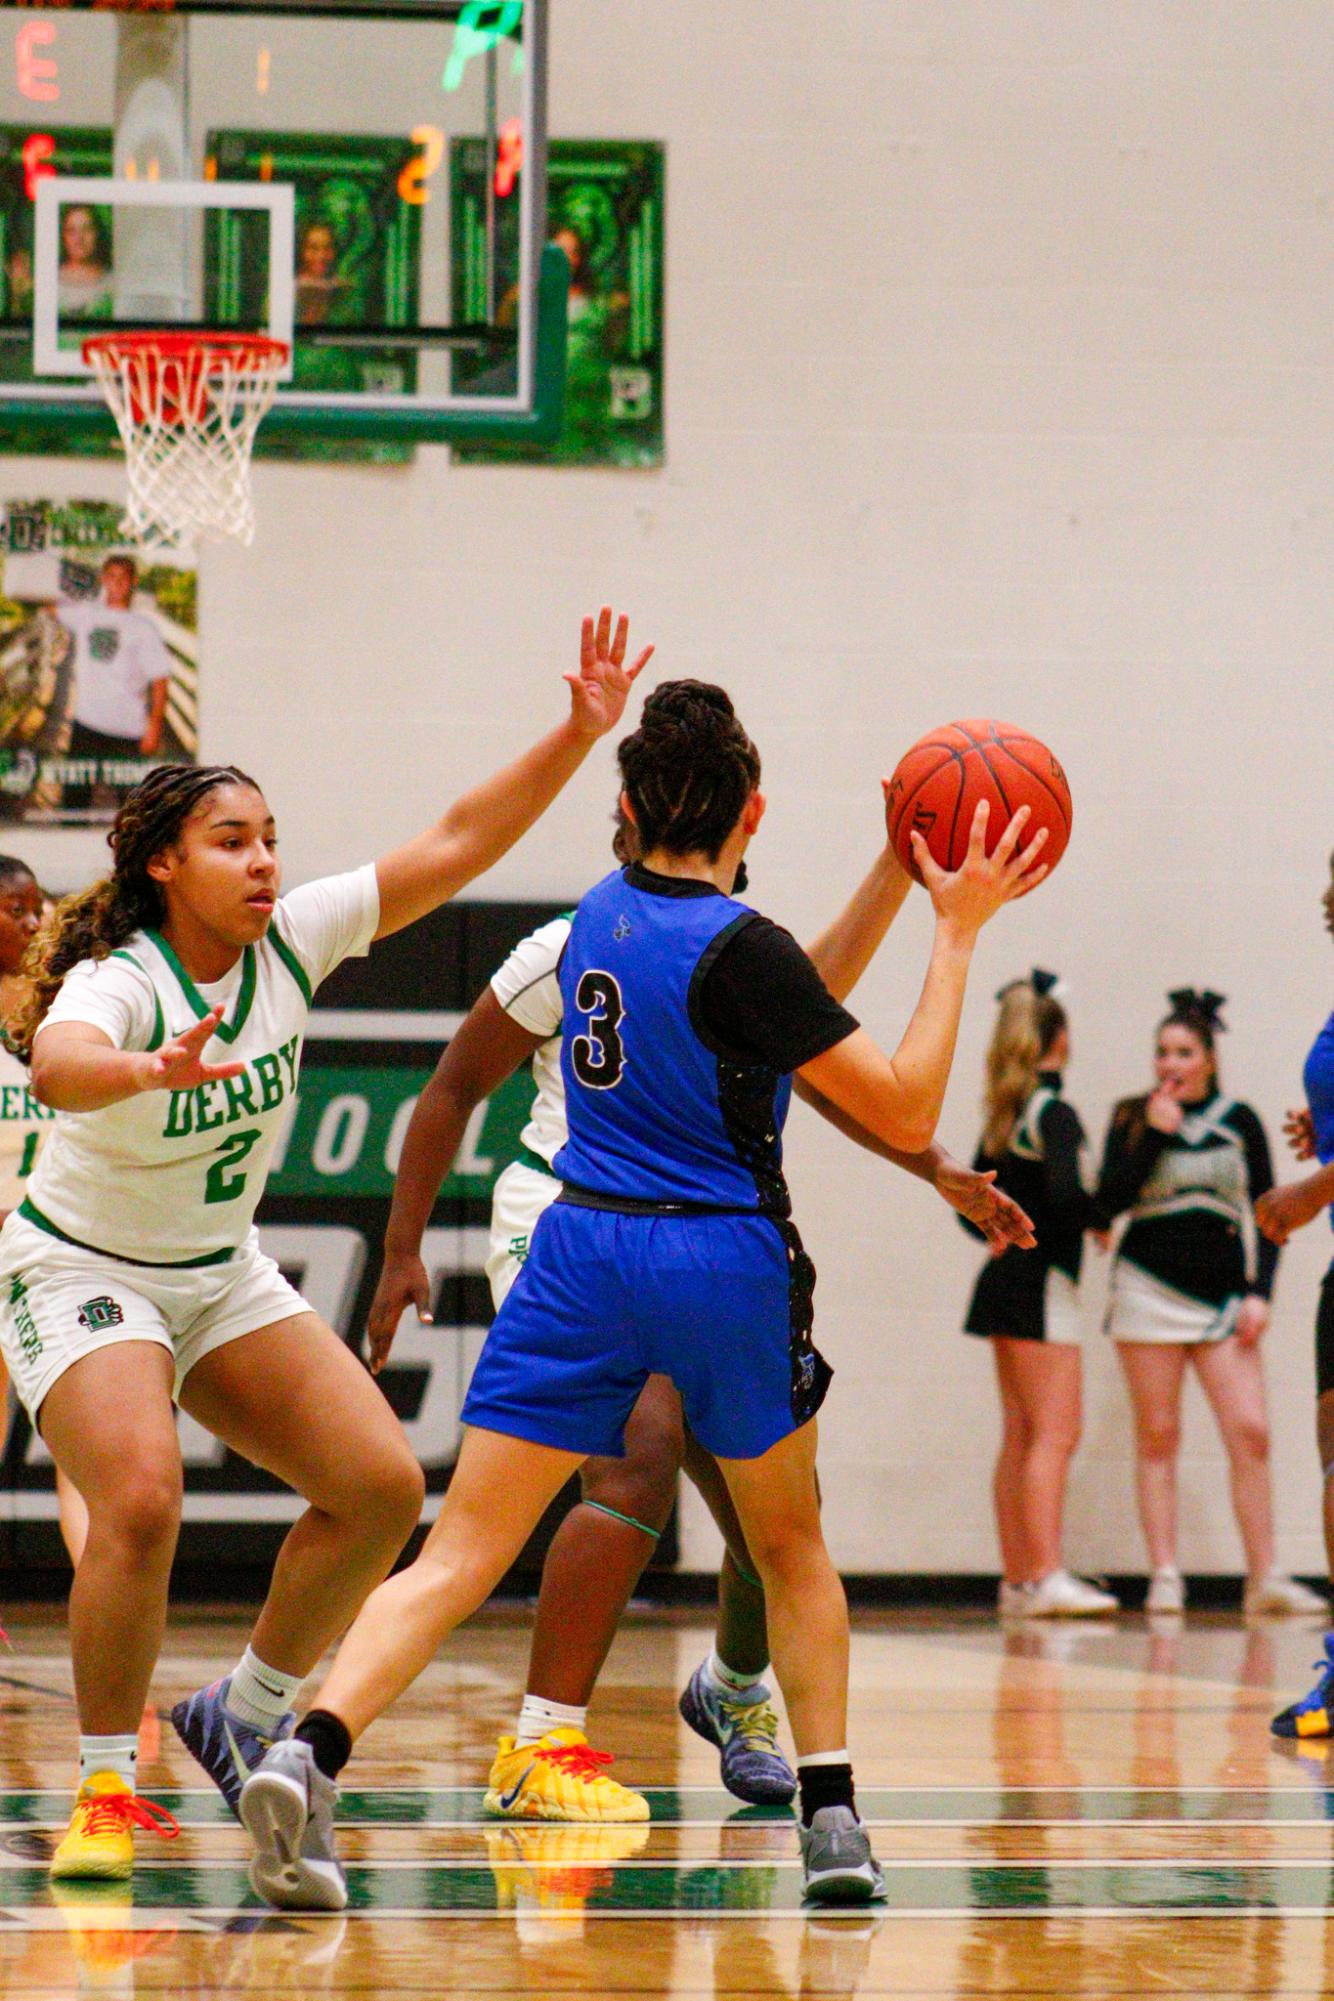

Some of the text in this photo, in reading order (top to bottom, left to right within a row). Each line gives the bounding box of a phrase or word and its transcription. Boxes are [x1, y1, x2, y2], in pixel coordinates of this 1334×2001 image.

[571, 968, 628, 1090] 3
[163, 1034, 299, 1138] DERBY
[204, 1128, 263, 1205] 2
